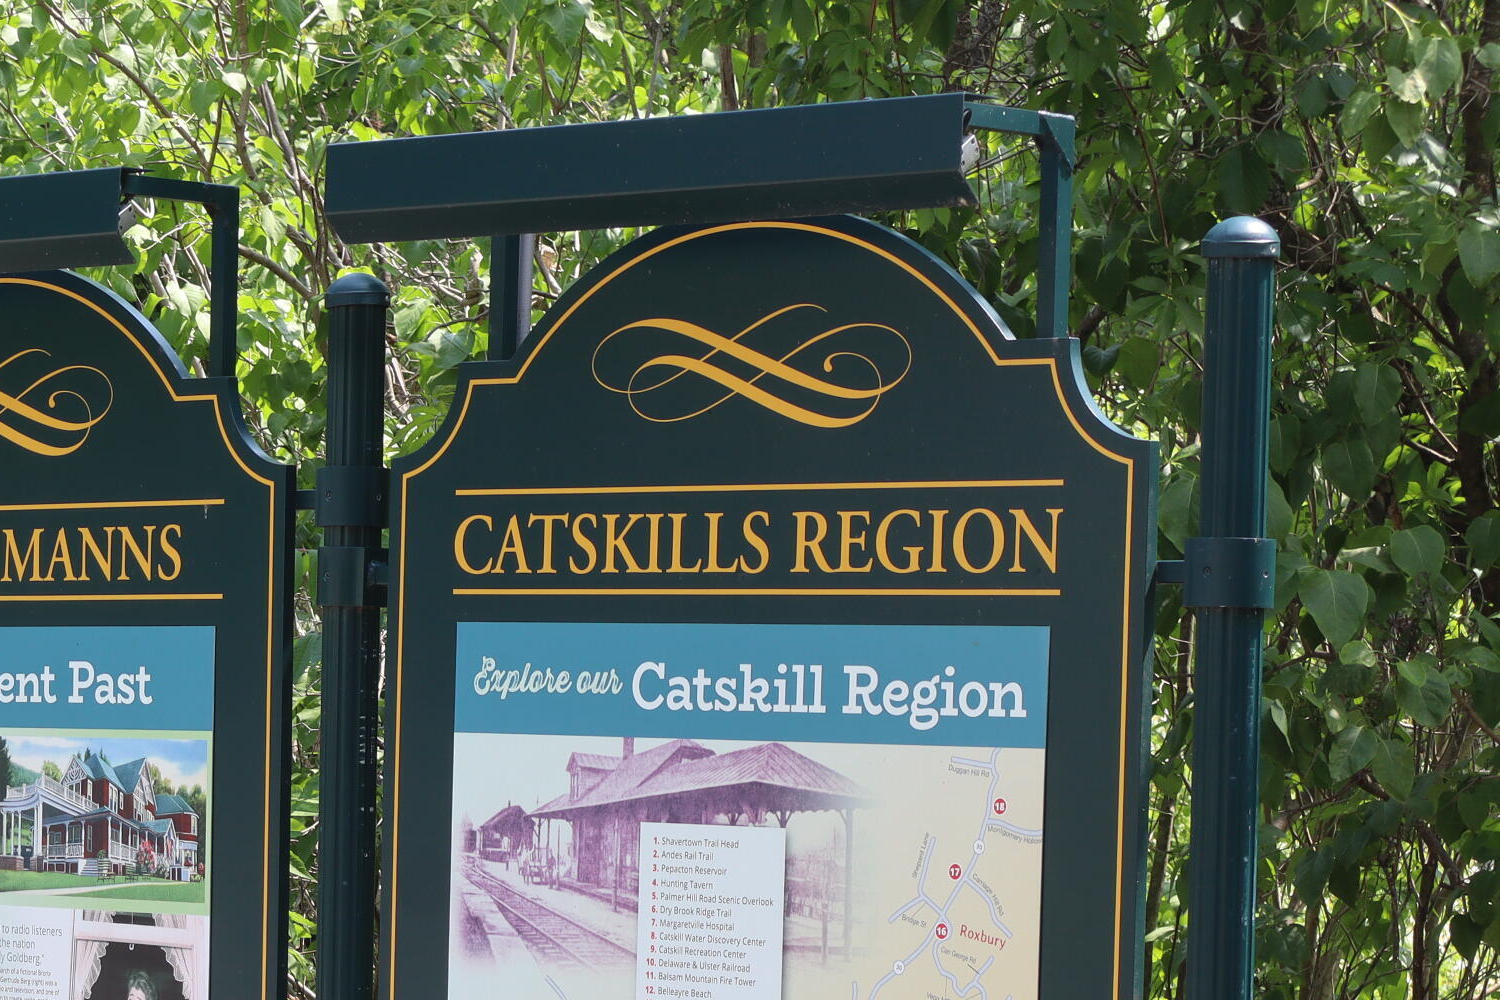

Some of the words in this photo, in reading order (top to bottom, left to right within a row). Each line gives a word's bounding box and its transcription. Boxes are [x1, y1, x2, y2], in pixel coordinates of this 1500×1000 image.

[453, 510, 770, 575] CATSKILLS
[790, 508, 1063, 574] REGION
[68, 660, 153, 705] Past
[474, 656, 572, 700] Explore
[576, 666, 623, 695] our
[631, 661, 826, 714] Catskill
[842, 664, 1027, 730] Region
[654, 837, 660, 845] 1.
[661, 837, 702, 846] Shavertown
[704, 839, 718, 847] Trail
[721, 840, 739, 848] Head
[653, 850, 660, 859] 2.
[662, 851, 682, 859] Andes
[684, 851, 697, 859] Rail
[698, 852, 714, 860] Trail
[653, 864, 659, 873] 3.
[661, 864, 693, 874] Pepacton
[695, 866, 728, 875] Reservoir
[652, 879, 659, 887] 4.
[660, 880, 688, 890] Hunting
[690, 880, 714, 889] Tavern
[652, 892, 658, 901] 5.
[660, 892, 684, 901] Palmer
[699, 894, 717, 903] Road
[718, 896, 740, 904] Scenic
[742, 897, 773, 906] Overlook
[652, 905, 658, 914] 6.
[660, 906, 672, 915] Dry
[674, 906, 694, 915] Brook
[696, 908, 715, 918] Ridge
[717, 909, 732, 917] Trail
[2, 925, 9, 934] to
[12, 925, 30, 934] radio
[32, 926, 62, 936] listeners
[652, 918, 658, 927] 7.
[660, 919, 704, 929] Margaretville
[706, 922, 735, 931] Hospital
[0, 938, 10, 947] the
[13, 940, 35, 949] nation
[651, 932, 657, 940] 8.
[659, 932, 683, 941] Catskill
[685, 934, 706, 942] Water
[707, 935, 741, 946] Discovery
[743, 937, 765, 946] Center
[960, 924, 1007, 950] Roxbury
[646, 958, 657, 967] 10.
[659, 959, 690, 968] Delaware
[692, 961, 697, 969] &
[700, 962, 720, 970] Ulster
[722, 963, 751, 972] Railroad
[646, 986, 656, 995] 12.
[658, 987, 689, 997] Belleayre
[691, 989, 712, 998] Beach
